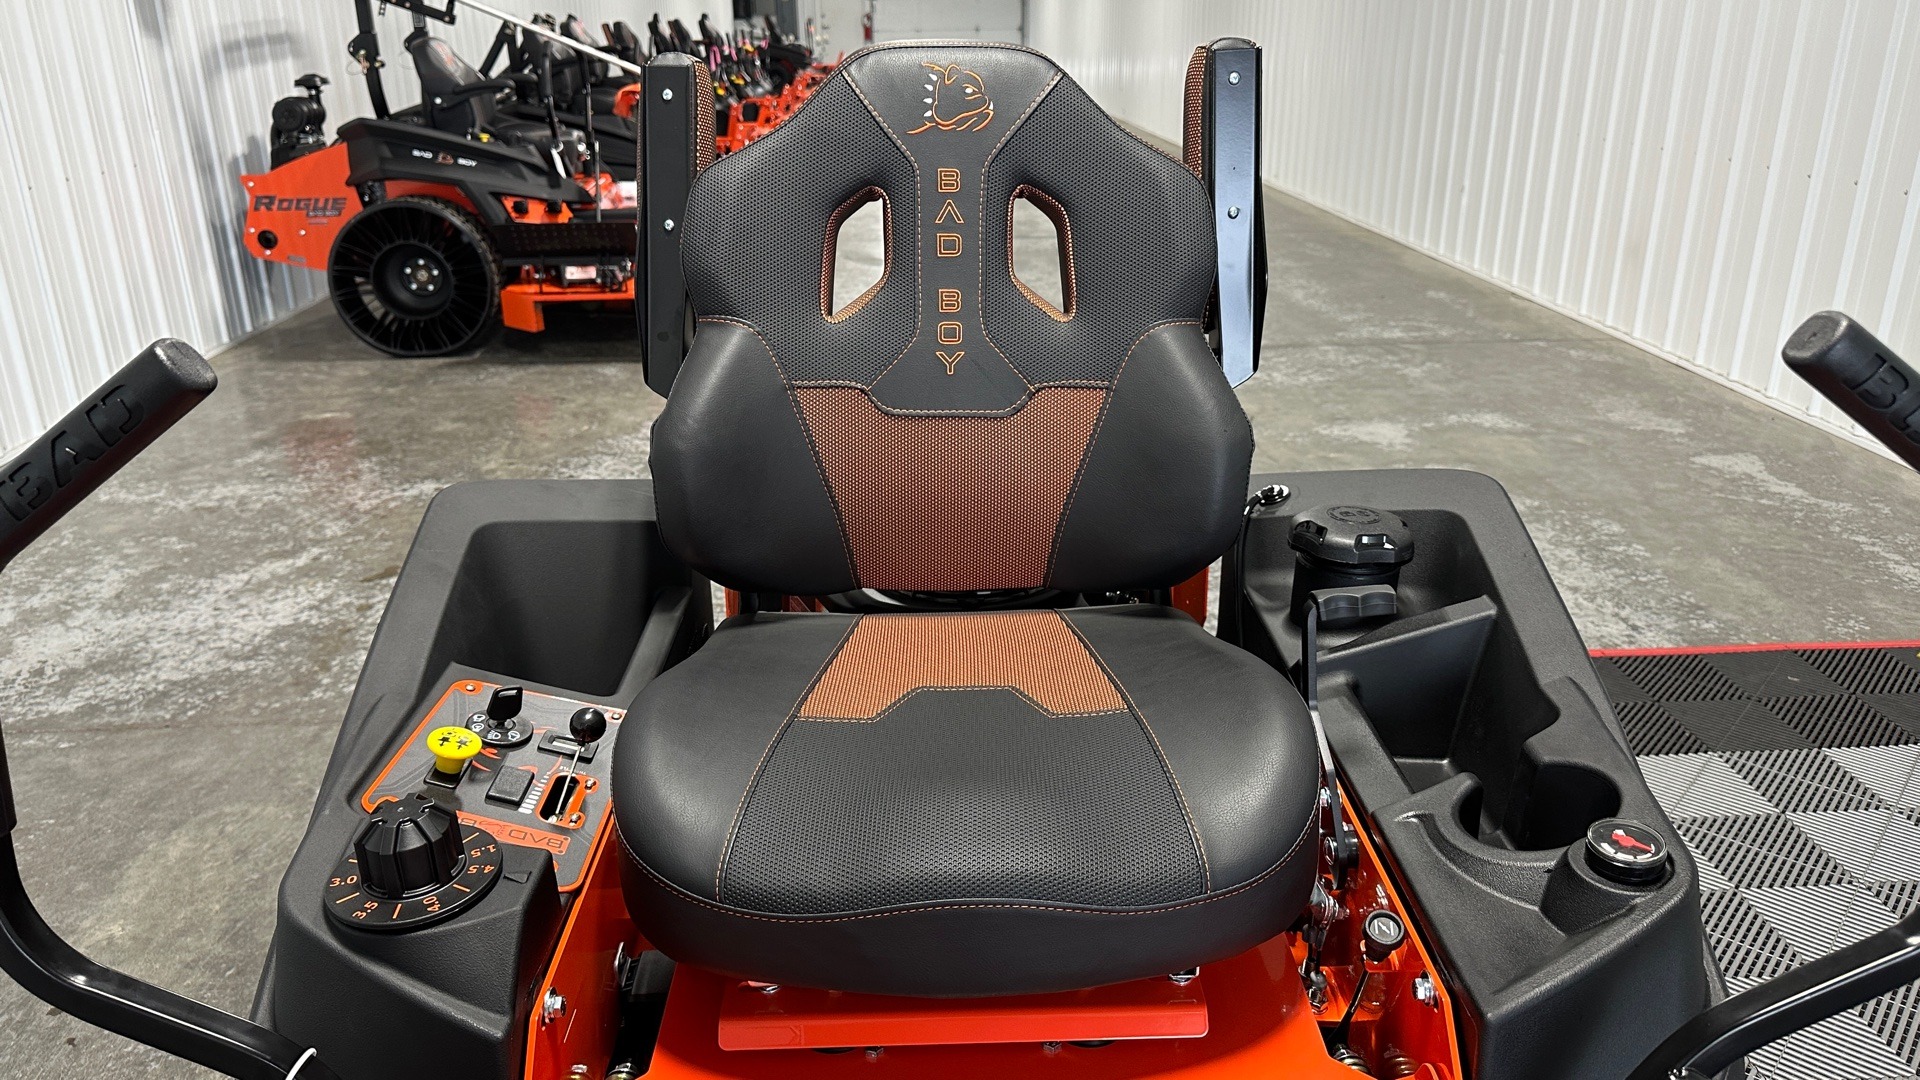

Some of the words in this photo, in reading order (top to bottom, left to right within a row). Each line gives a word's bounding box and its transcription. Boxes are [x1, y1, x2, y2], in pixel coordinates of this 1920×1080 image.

[935, 168, 964, 257] BAD
[936, 289, 965, 375] BOY
[0, 384, 146, 522] BAD
[508, 829, 564, 848] BAD
[470, 843, 497, 858] 1.5
[467, 864, 495, 874] 4.5
[329, 875, 358, 887] 3.0
[352, 901, 379, 920] 3.5
[422, 895, 441, 912] 4.0
